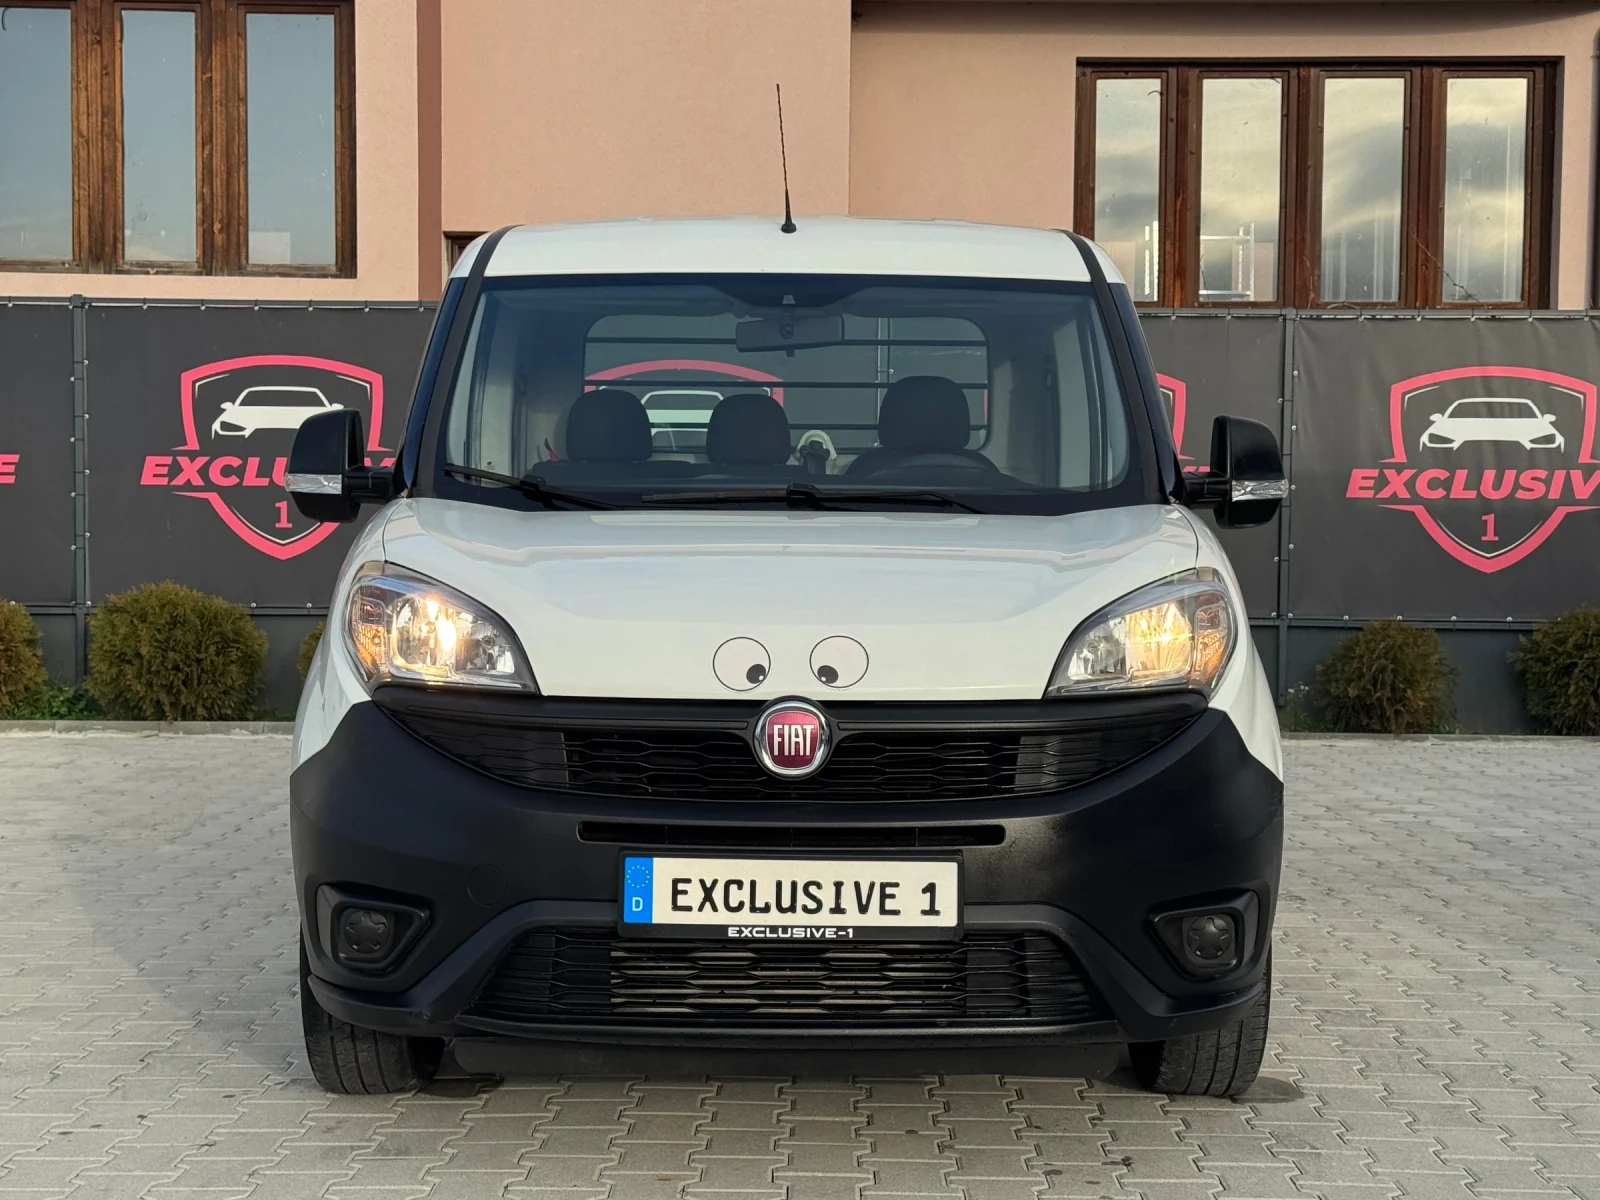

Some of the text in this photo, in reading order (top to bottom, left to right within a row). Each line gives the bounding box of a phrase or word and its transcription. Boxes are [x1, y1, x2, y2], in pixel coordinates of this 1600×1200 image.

[1346, 468, 1600, 500] EXCLUSIV
[275, 501, 293, 528] 1
[1481, 513, 1499, 541] 1
[772, 724, 815, 756] FIAT
[632, 897, 643, 911] D
[671, 877, 941, 917] EXCLUSIVE 1
[727, 926, 854, 938] EXCLUSIVE-1
